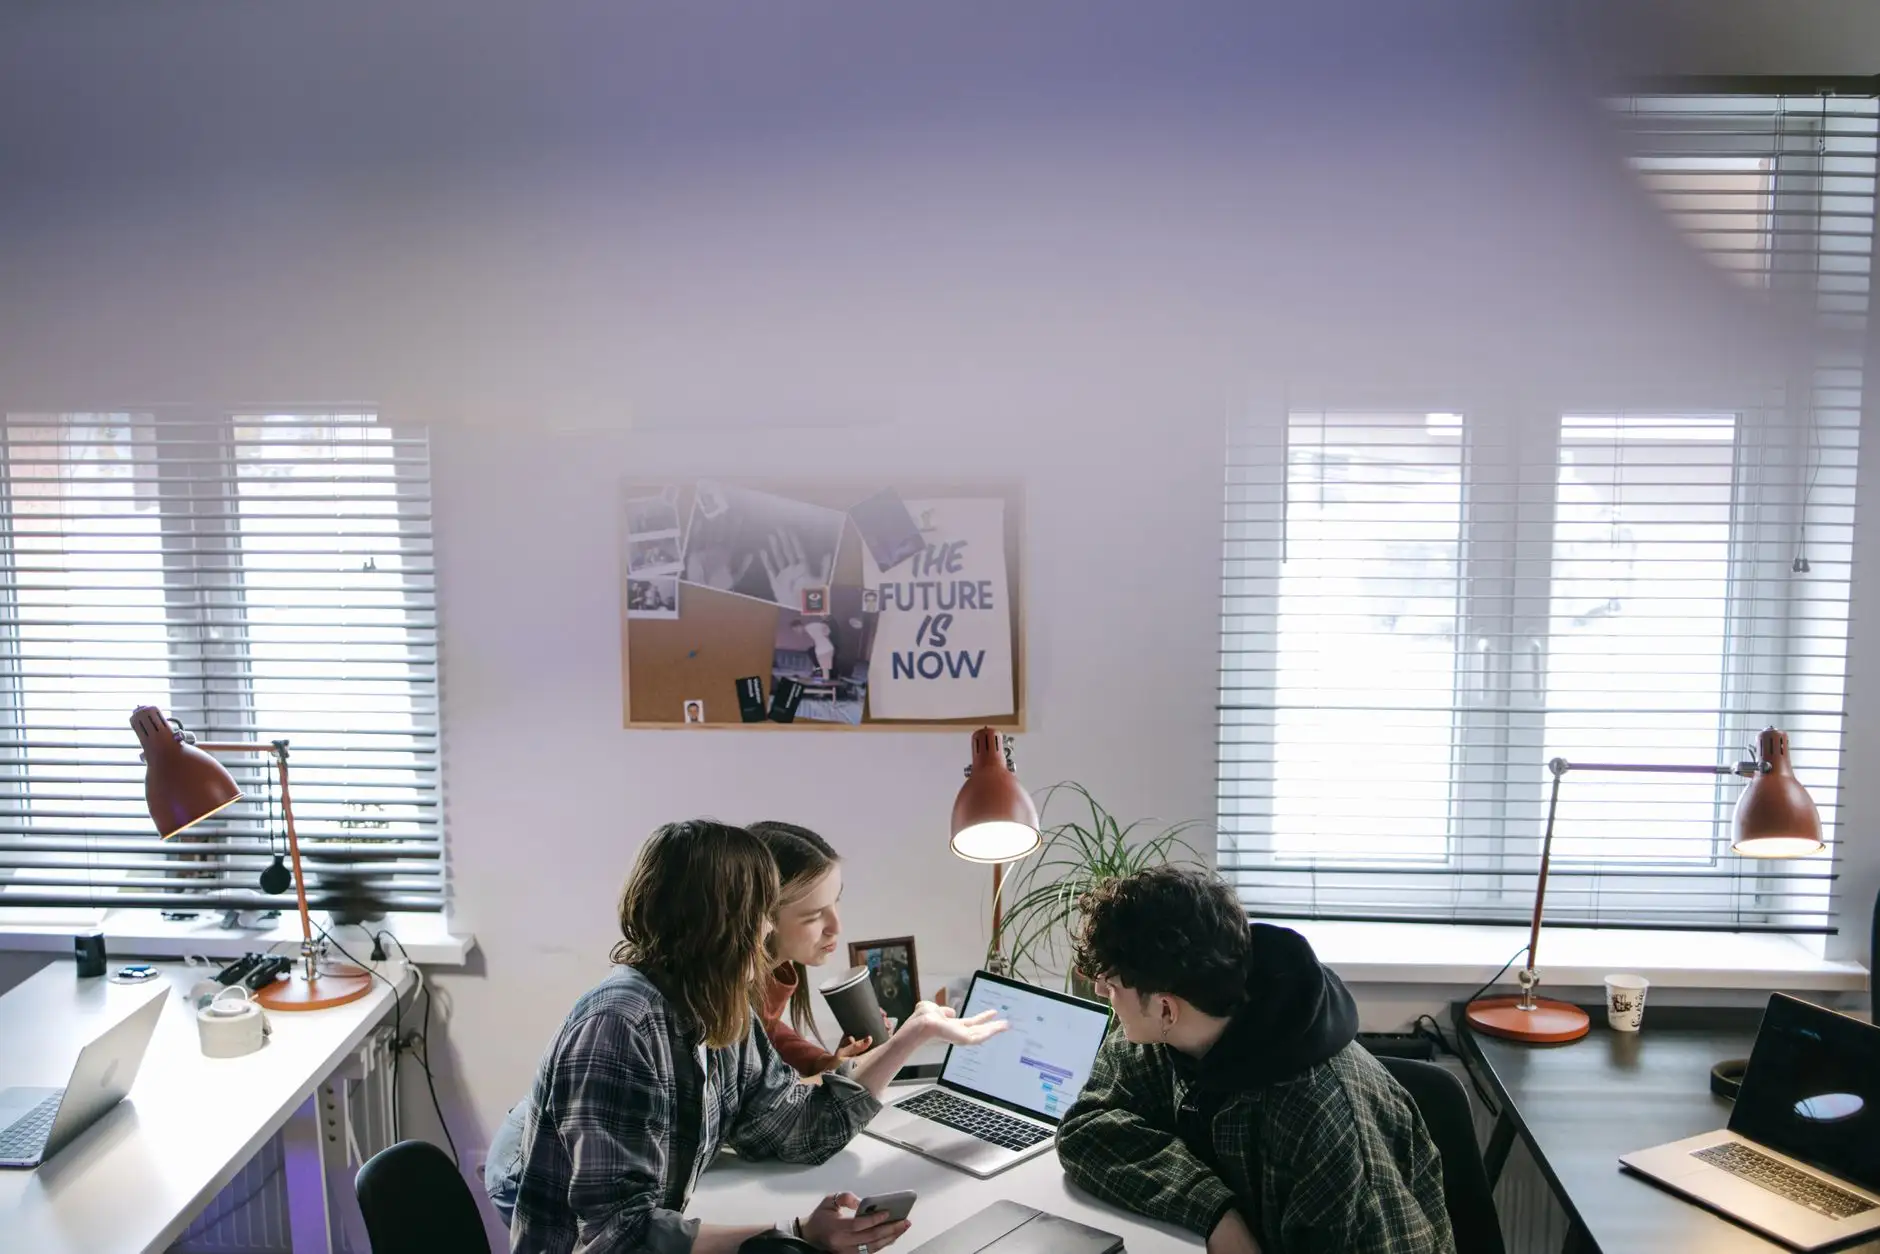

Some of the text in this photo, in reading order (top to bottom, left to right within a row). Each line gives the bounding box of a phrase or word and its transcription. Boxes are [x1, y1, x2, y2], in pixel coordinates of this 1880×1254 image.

[878, 580, 994, 611] FUTURE
[915, 613, 953, 647] IS
[892, 650, 986, 679] NOW
